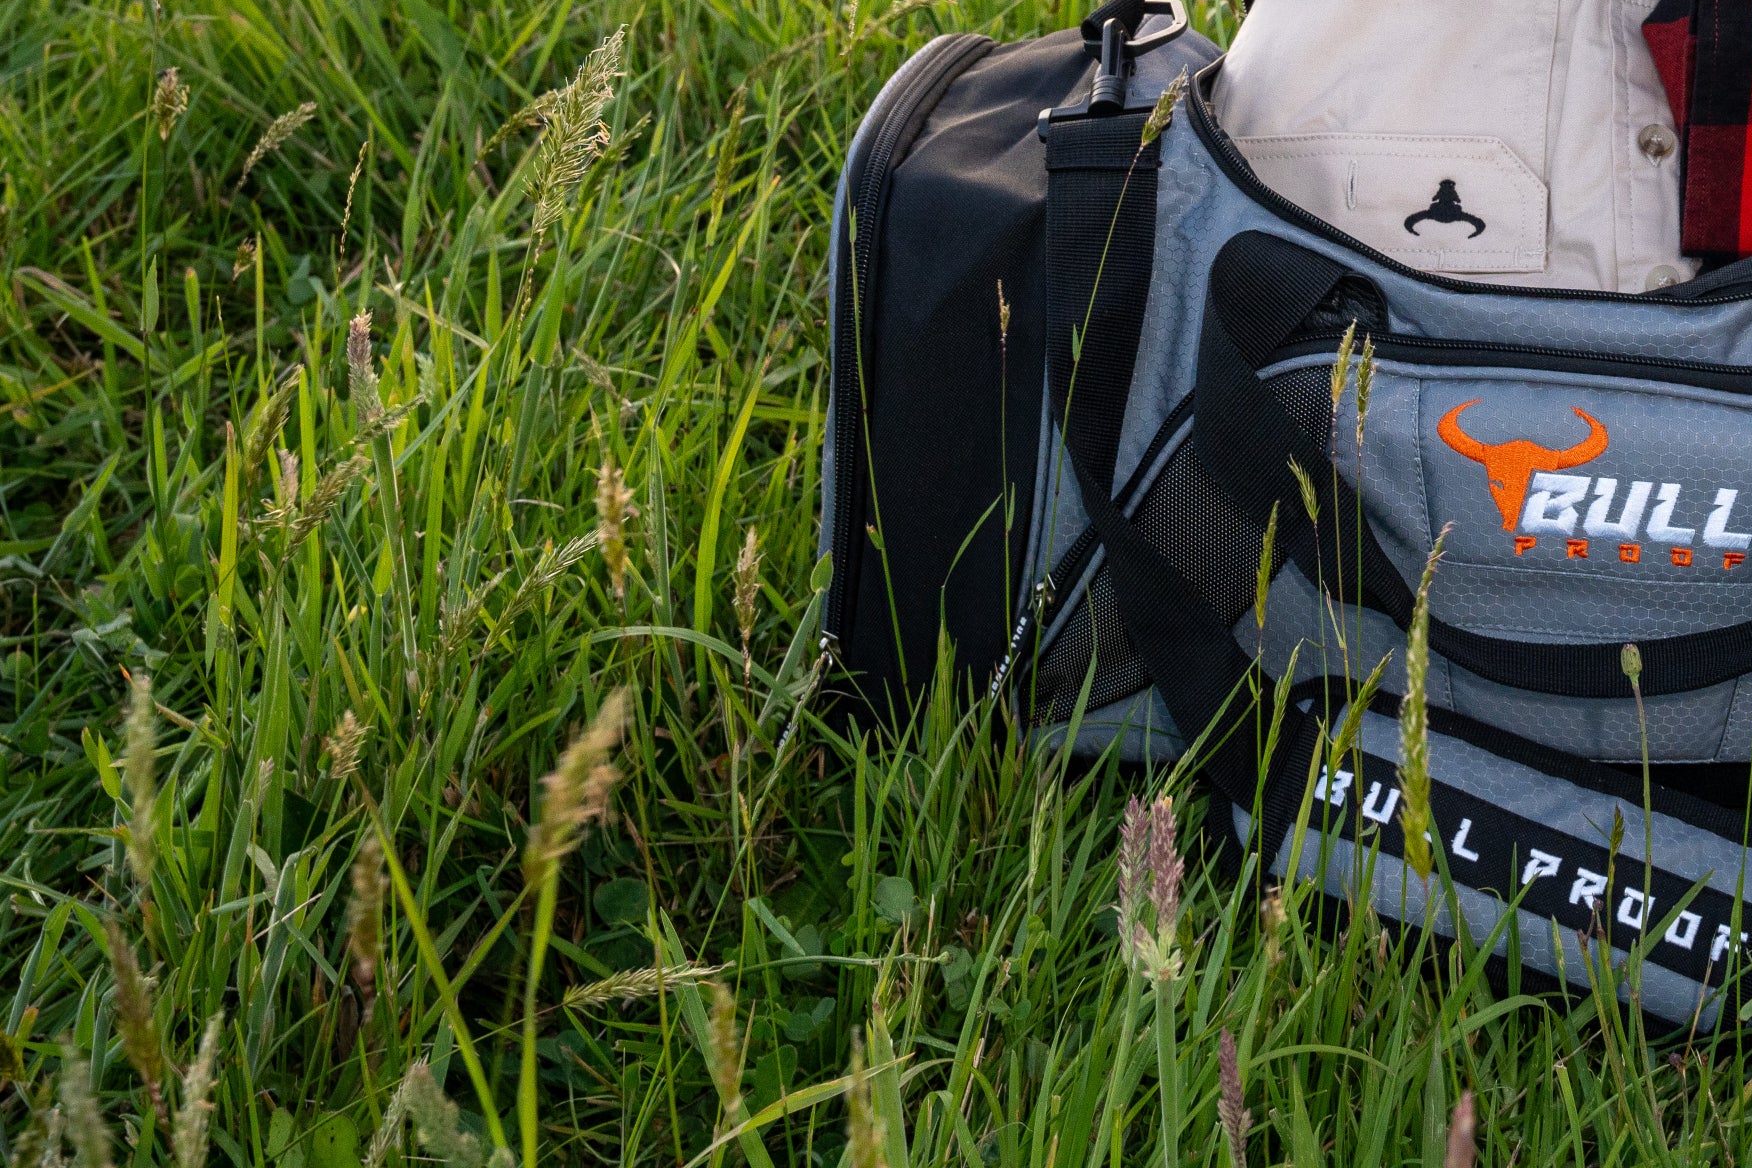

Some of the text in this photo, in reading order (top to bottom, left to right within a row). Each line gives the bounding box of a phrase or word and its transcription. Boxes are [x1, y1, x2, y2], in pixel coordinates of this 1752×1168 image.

[1520, 472, 1752, 550] BULL
[1514, 535, 1746, 571] PROOF
[1314, 764, 1480, 863] BUL
